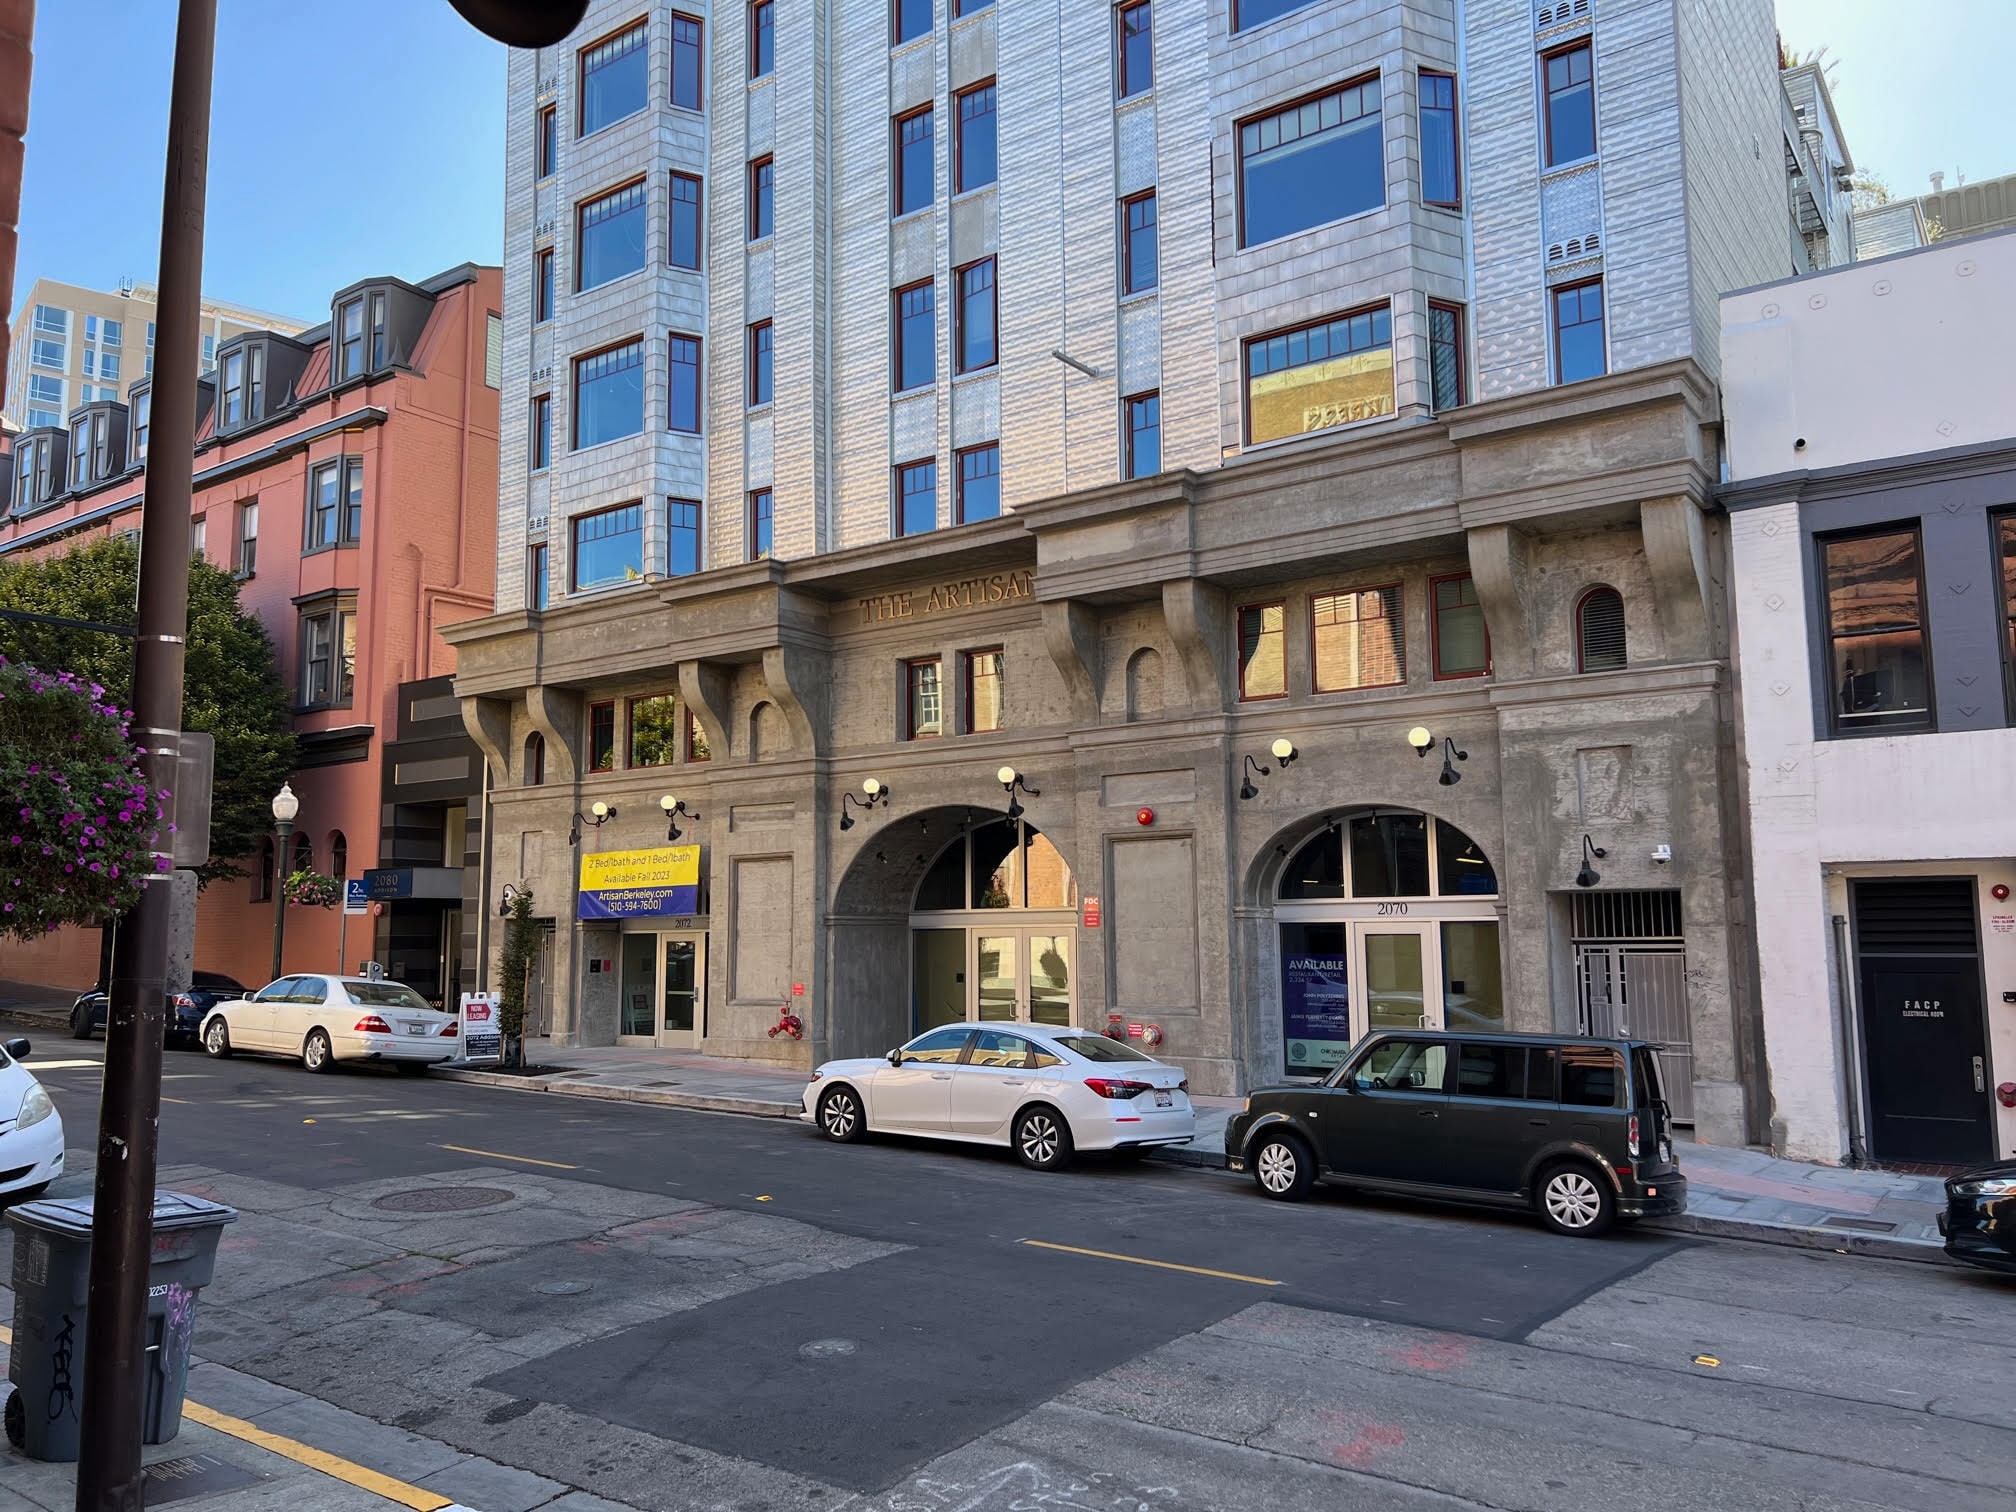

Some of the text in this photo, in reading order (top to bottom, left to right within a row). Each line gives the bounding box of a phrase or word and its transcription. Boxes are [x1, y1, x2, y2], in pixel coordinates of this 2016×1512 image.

[859, 591, 913, 624] THE
[588, 860, 593, 868] 2
[632, 857, 646, 866] and
[375, 874, 398, 887] 2080
[604, 870, 670, 884] Available Fall 2023
[598, 888, 673, 901] ArtisanBerkeley.com
[608, 898, 662, 913] (510-594-7600)
[1377, 902, 1408, 915] 2070
[675, 919, 691, 928] 2072
[1288, 960, 1344, 970] AVAILABLE
[467, 1012, 487, 1020] LEASING
